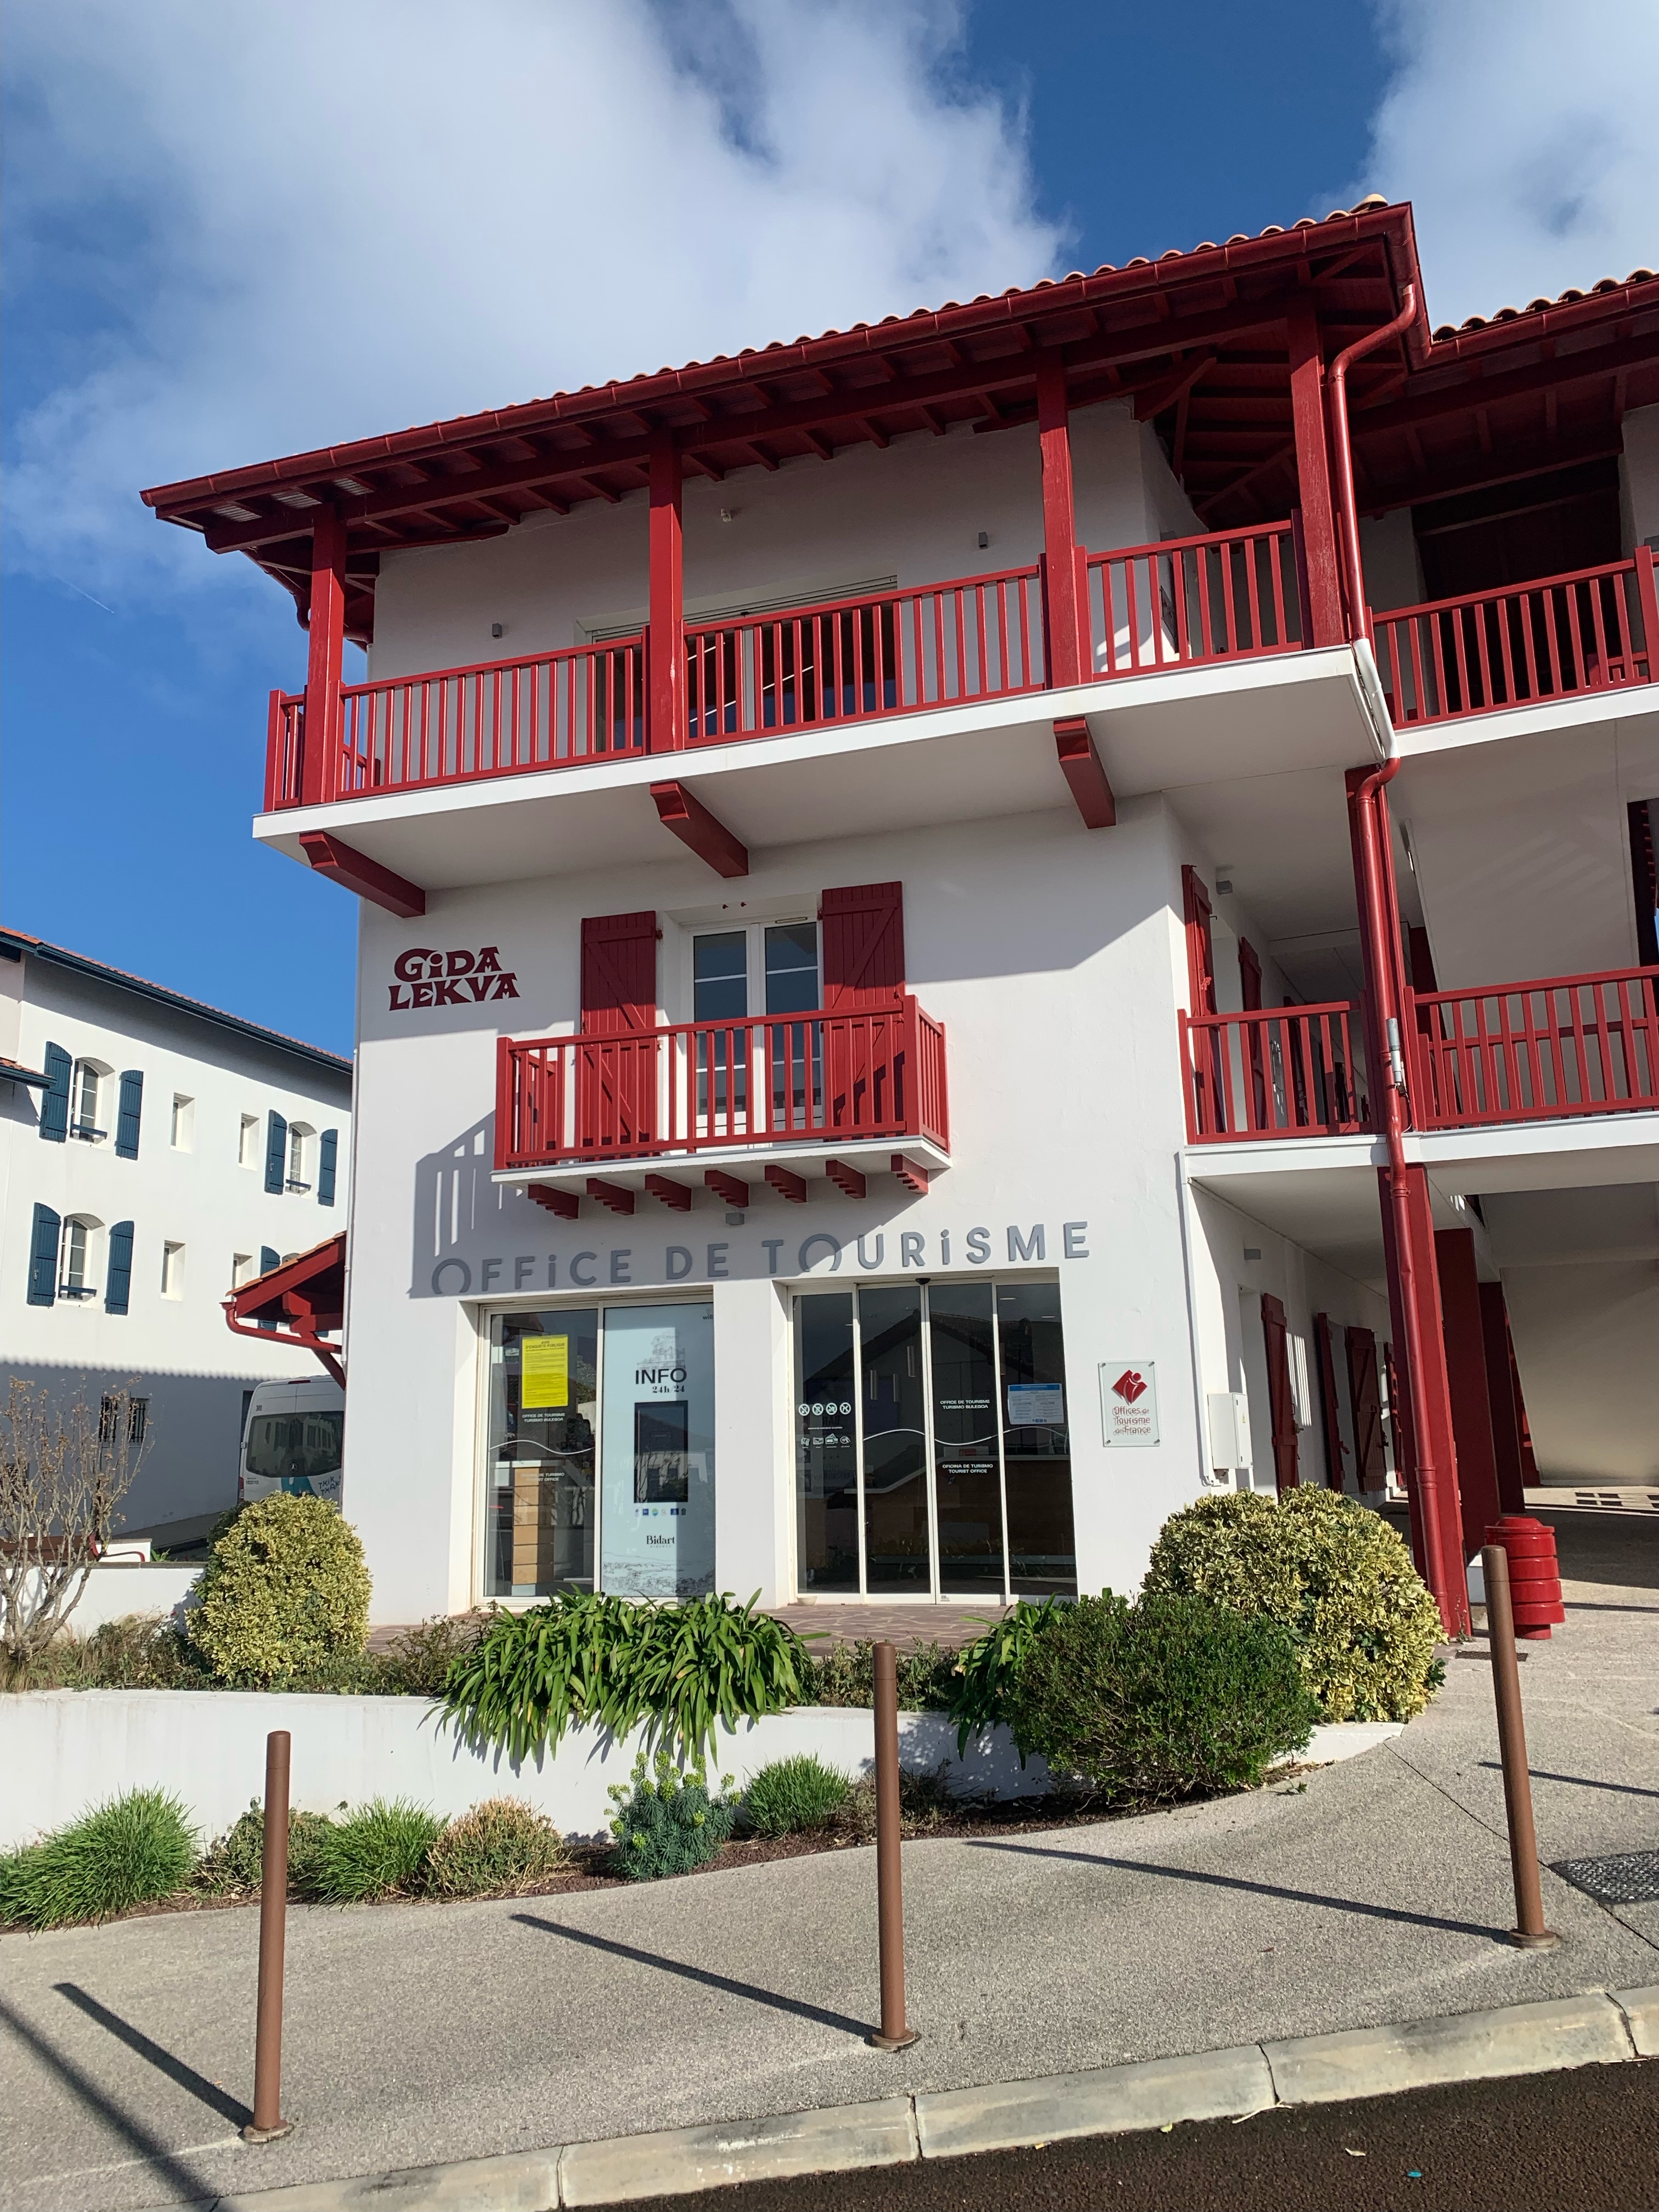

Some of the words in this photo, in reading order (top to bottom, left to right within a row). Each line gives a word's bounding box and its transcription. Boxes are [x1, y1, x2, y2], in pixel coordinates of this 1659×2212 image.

[665, 1243, 729, 1279] DE
[635, 1368, 687, 1385] INFO
[652, 1385, 685, 1393] 24h/24
[1114, 1406, 1140, 1414] Offices
[646, 1535, 675, 1544] Bidart
